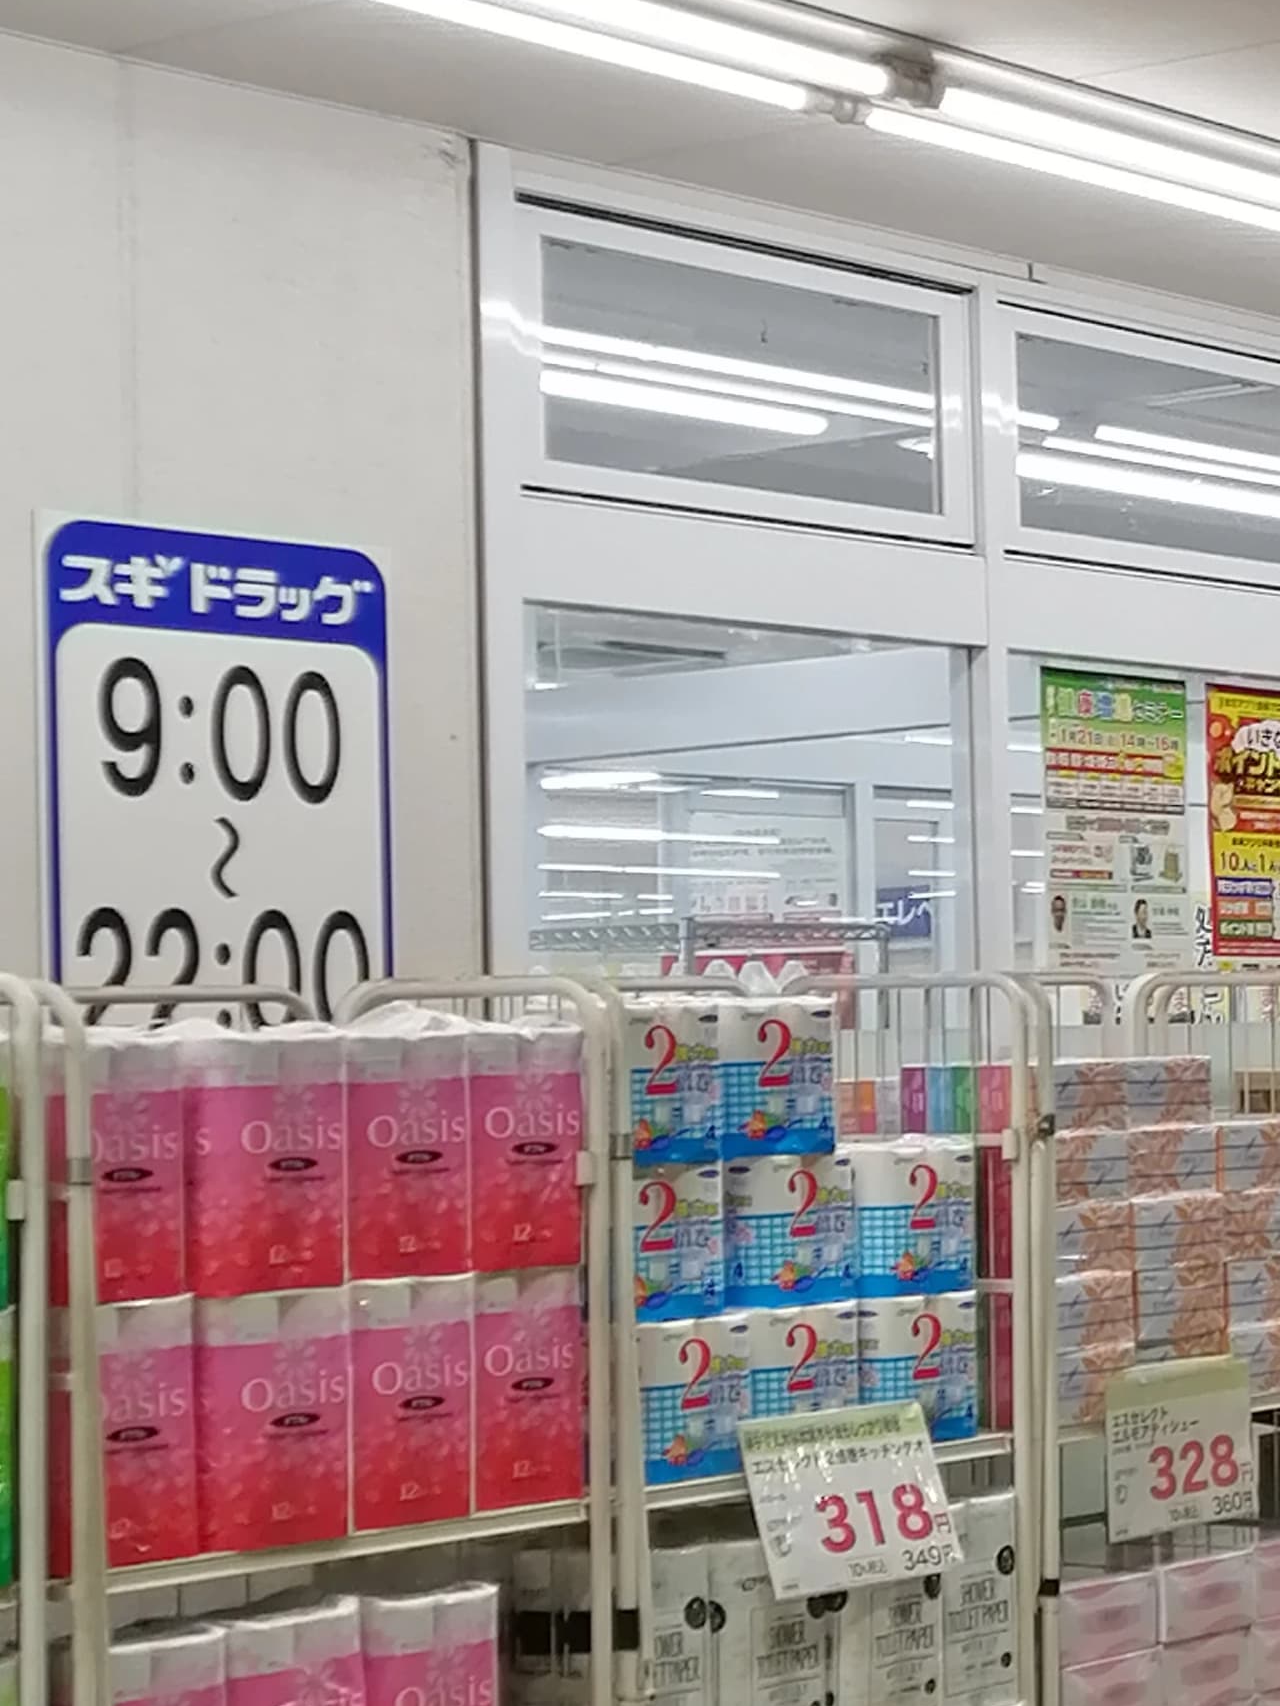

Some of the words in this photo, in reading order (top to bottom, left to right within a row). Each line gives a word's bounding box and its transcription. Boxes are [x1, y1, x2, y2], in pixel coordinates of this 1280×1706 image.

[59, 552, 185, 608] スギ
[189, 562, 376, 626] ドラッグ
[100, 655, 341, 805] 9:00
[76, 905, 371, 1031] 22:00
[240, 1117, 342, 1154] Oasis
[366, 1110, 464, 1148] Oasis
[485, 1104, 580, 1139] Oasis
[92, 1124, 178, 1162] asis
[372, 1354, 468, 1394] Oasis
[484, 1338, 575, 1377] Oasis
[100, 1383, 186, 1422] asis
[241, 1370, 346, 1413] Oasis
